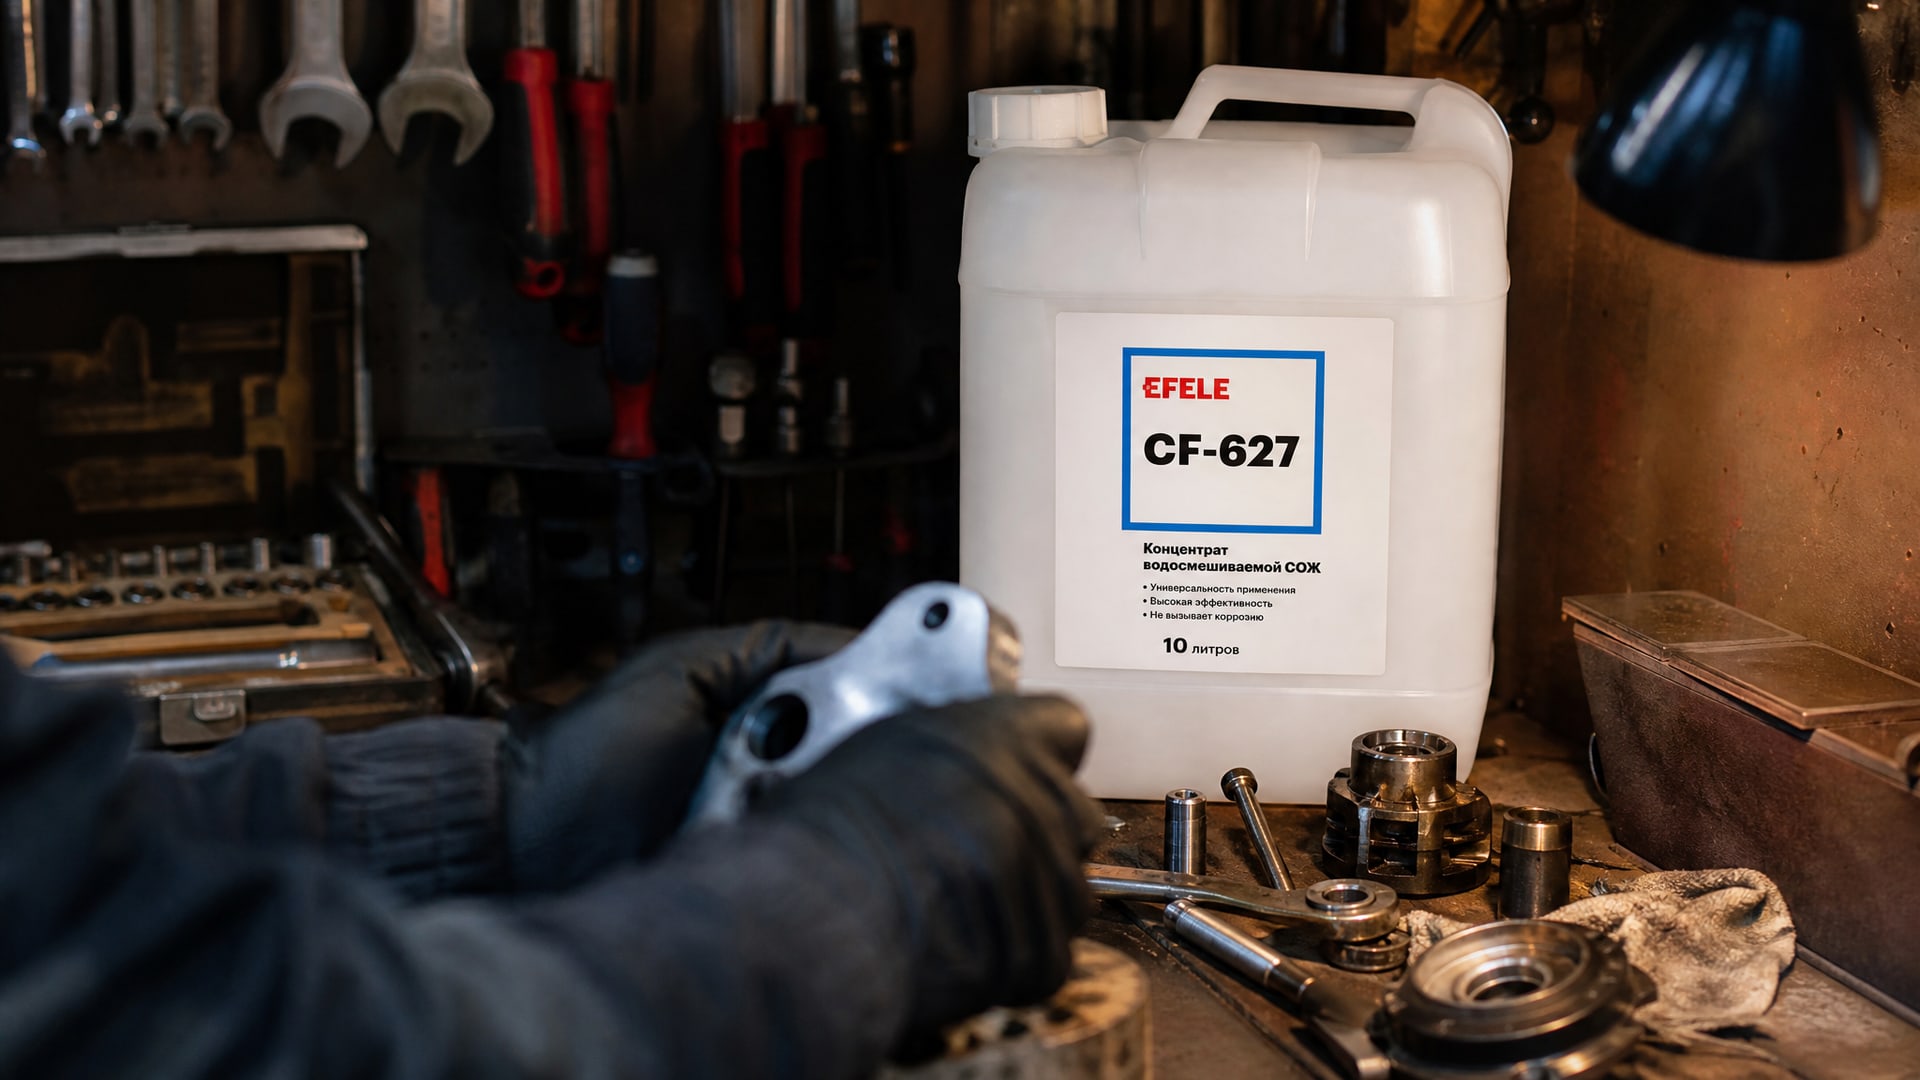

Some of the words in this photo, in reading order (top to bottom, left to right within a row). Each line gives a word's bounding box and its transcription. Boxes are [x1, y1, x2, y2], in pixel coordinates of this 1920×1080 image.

[1142, 377, 1229, 400] EFELE
[1144, 433, 1300, 467] CF-627
[1144, 542, 1228, 557] Концентрат
[1144, 560, 1281, 572] водосмешиваемой
[1285, 561, 1322, 574] СОЖ
[1151, 582, 1235, 594] Универсальность
[1237, 586, 1296, 596] применения
[1150, 596, 1193, 607] Высокая
[1195, 597, 1273, 609] эффективность
[1150, 610, 1164, 620] Не
[1166, 612, 1213, 621] вызывает
[1215, 613, 1264, 623] коррозию
[1163, 638, 1187, 653] 10
[1192, 645, 1240, 657] литров
